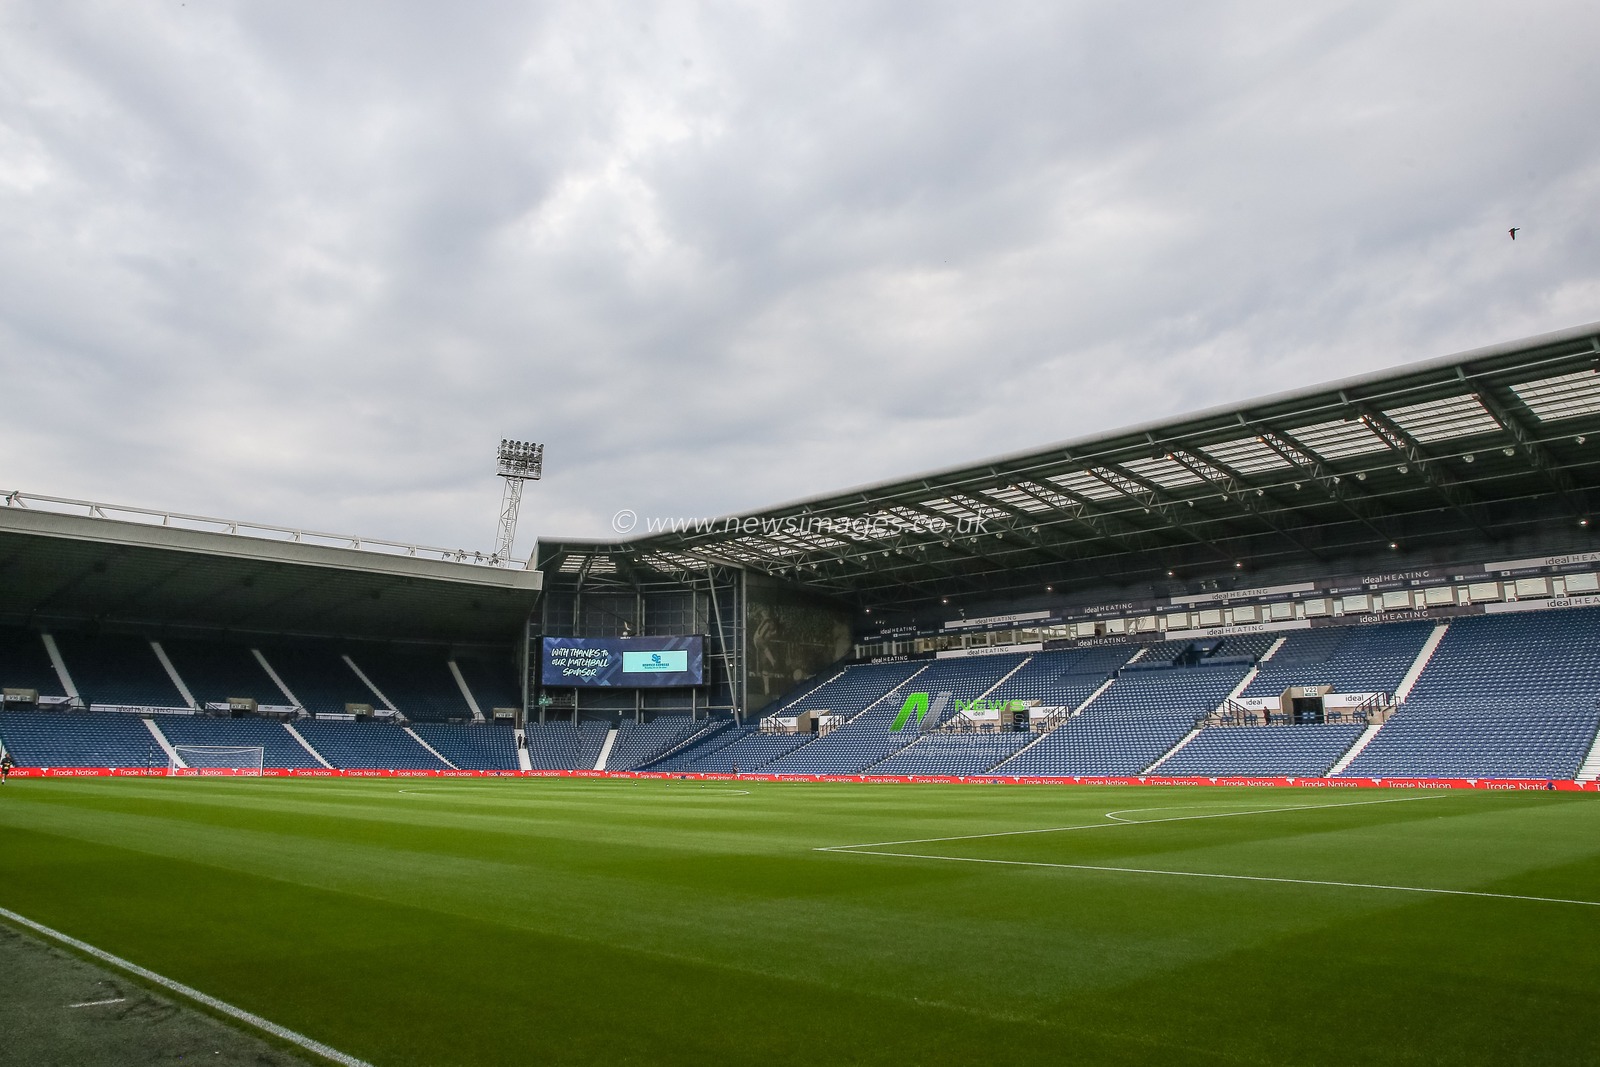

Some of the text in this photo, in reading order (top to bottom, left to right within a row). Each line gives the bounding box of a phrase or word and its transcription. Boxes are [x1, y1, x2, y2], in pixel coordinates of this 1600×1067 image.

[552, 648, 568, 658] WITH
[570, 648, 600, 658] THANKS
[552, 658, 609, 668] OUR MATCHBALL
[562, 668, 596, 677] SPONSOR
